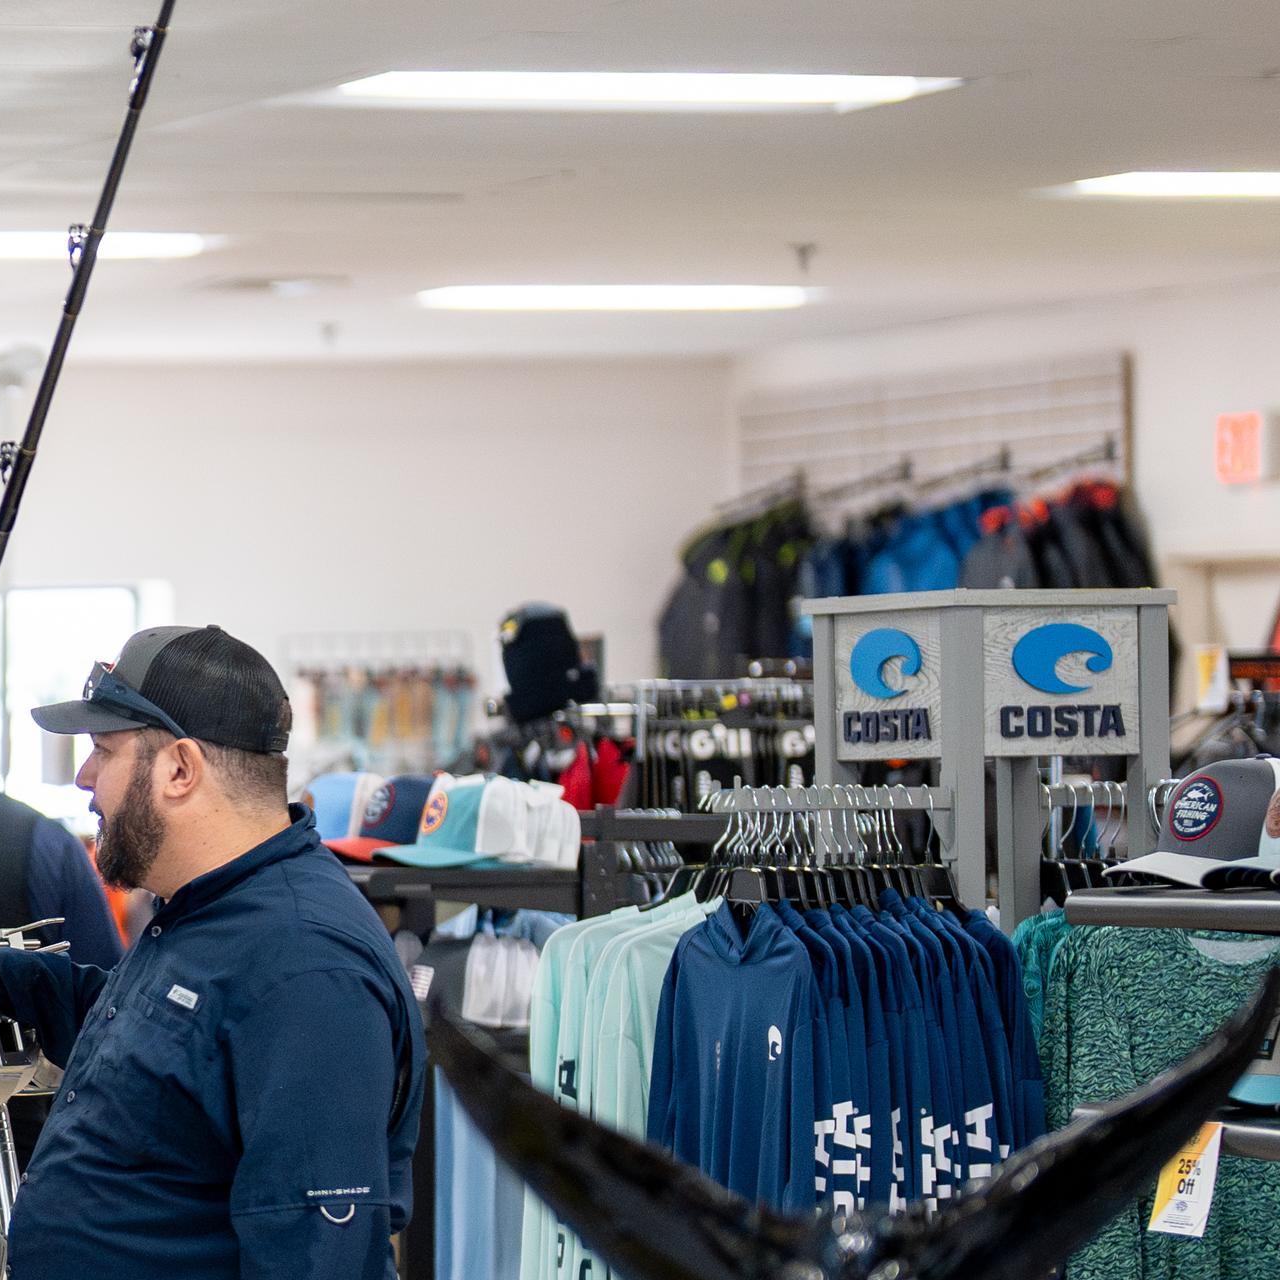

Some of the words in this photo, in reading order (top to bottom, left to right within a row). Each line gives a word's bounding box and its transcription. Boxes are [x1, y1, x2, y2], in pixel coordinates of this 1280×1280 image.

[843, 706, 932, 744] COSTA
[999, 703, 1126, 738] COSTA
[1177, 1178, 1195, 1196] Off
